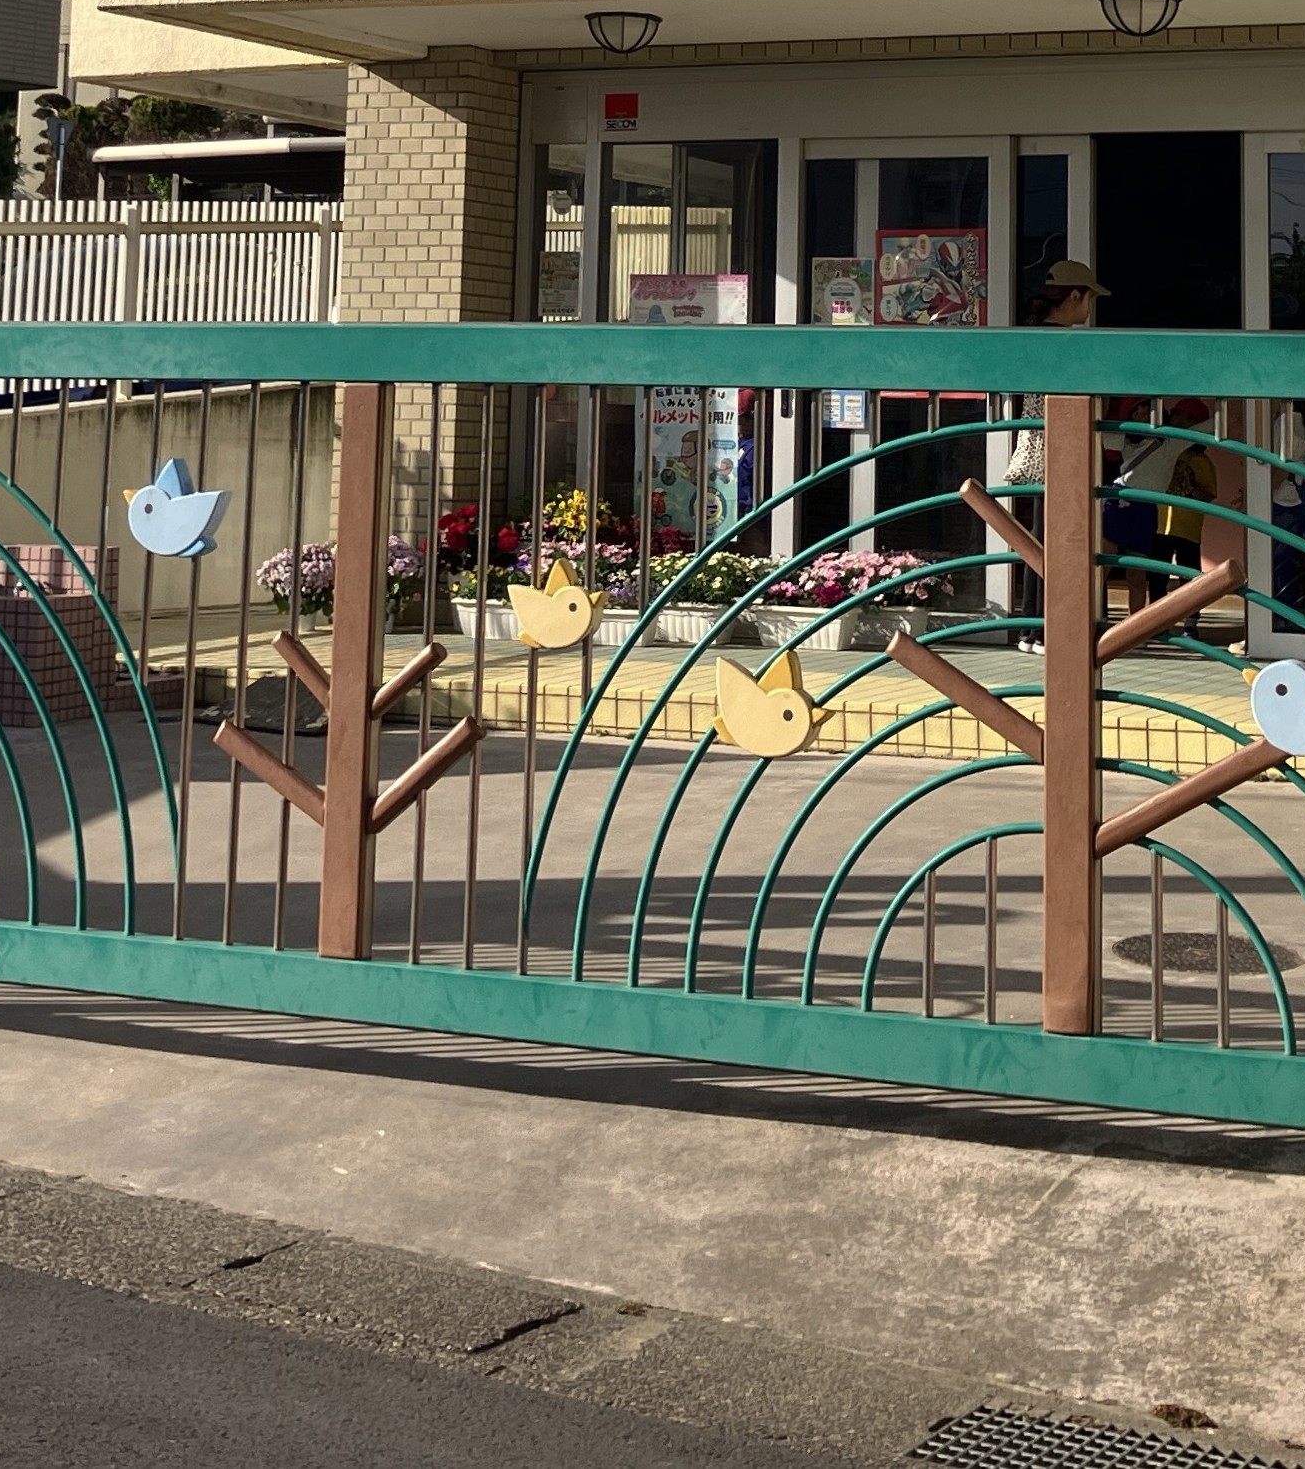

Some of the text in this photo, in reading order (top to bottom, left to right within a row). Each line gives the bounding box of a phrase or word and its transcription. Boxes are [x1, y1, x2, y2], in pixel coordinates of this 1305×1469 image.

[605, 119, 637, 129] SECOM
[640, 409, 735, 425] ルメット用!!
